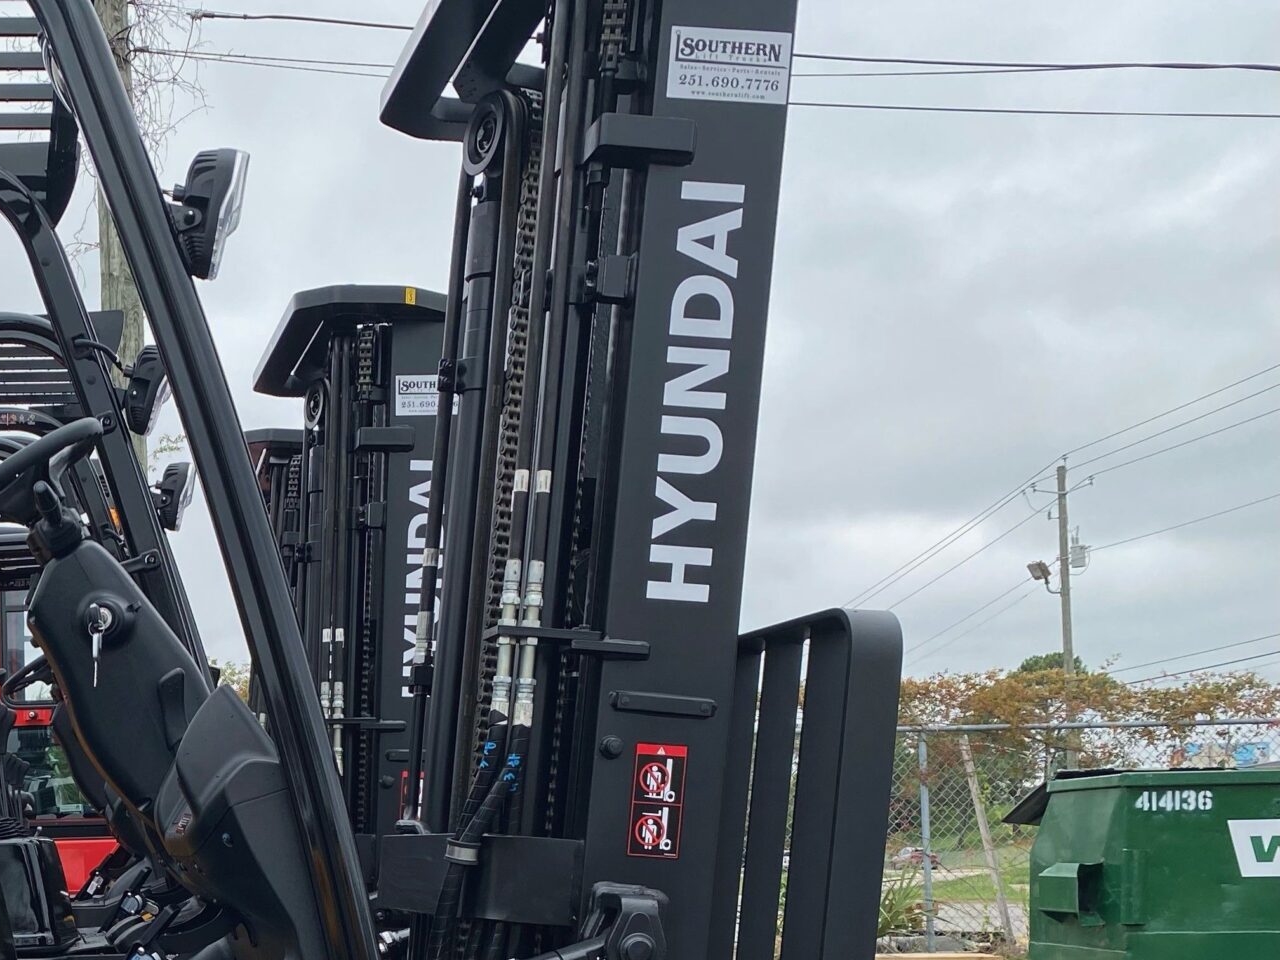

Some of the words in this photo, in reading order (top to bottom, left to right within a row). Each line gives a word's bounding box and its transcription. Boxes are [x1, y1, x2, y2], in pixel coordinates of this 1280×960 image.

[680, 37, 782, 62] SOUTHERN
[679, 74, 779, 92] 251.690.7776
[646, 180, 745, 603] HYUNDAI
[1135, 790, 1213, 811] 414136
